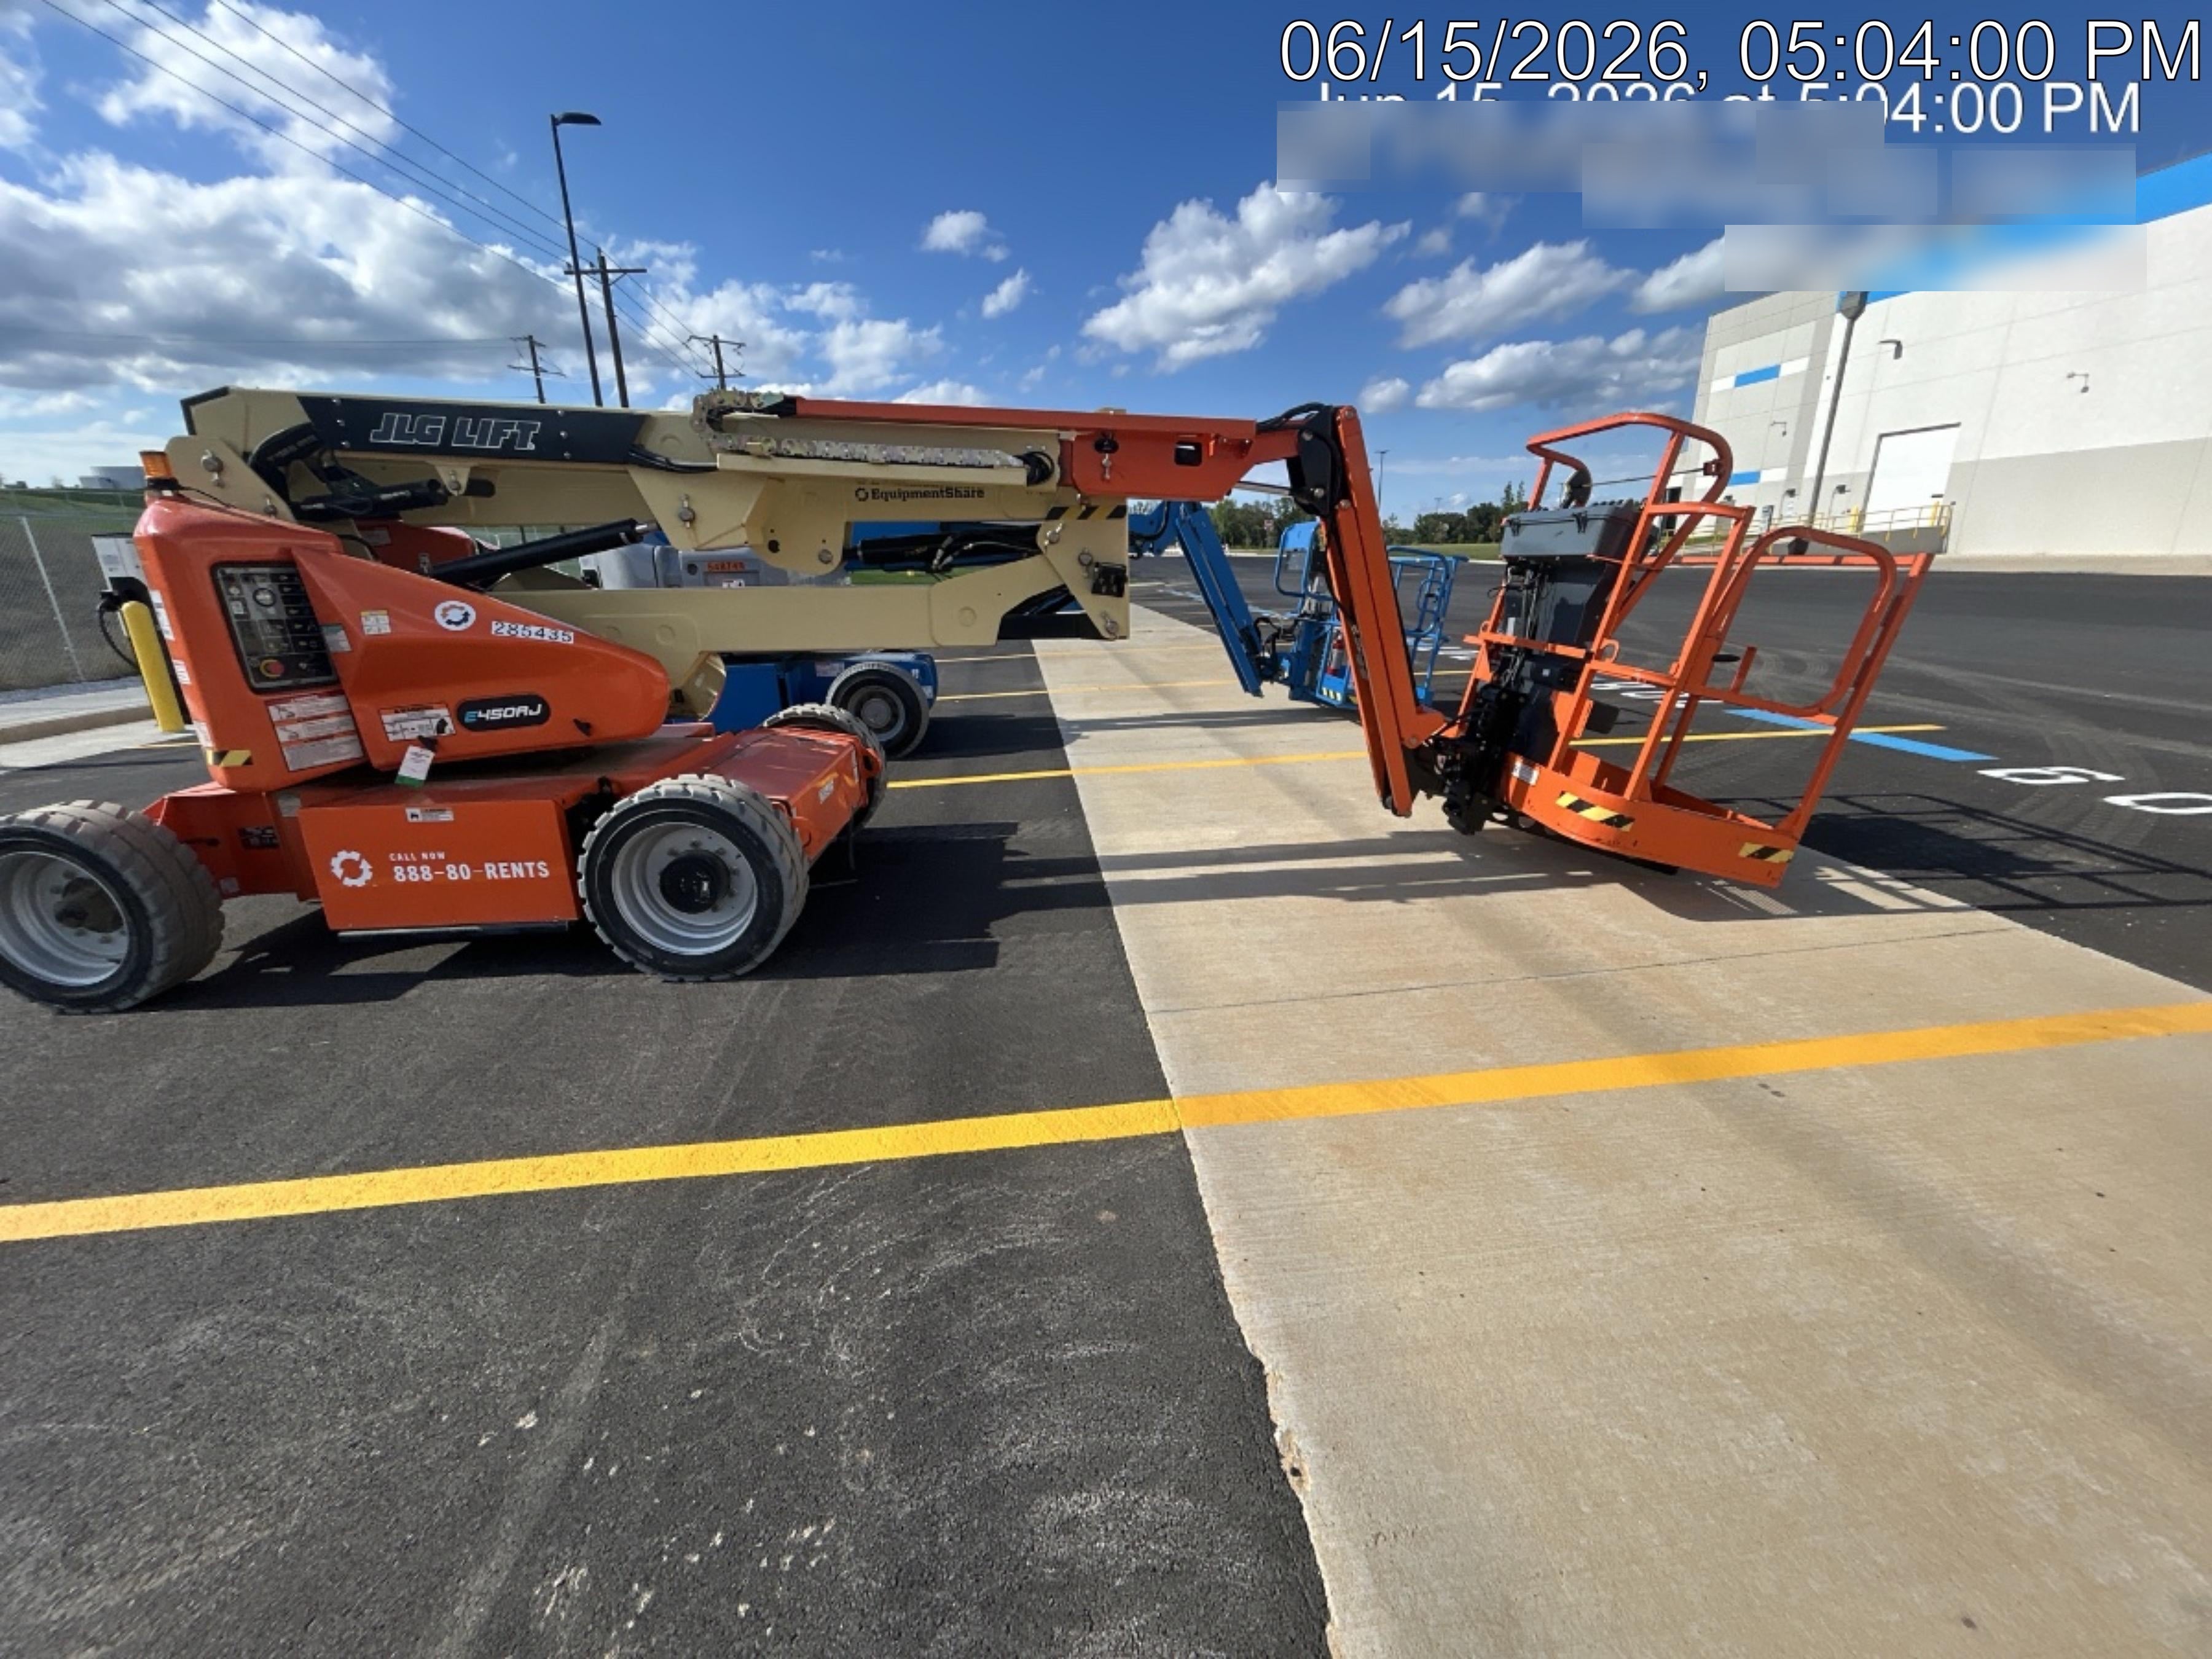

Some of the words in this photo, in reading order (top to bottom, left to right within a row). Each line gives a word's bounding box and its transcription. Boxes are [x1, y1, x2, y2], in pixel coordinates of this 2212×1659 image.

[370, 412, 447, 446] JLG
[451, 417, 541, 450] LIFT
[871, 487, 986, 502] EquipmentShare
[495, 622, 572, 642] 285435
[464, 704, 542, 723] E450AJ
[388, 852, 418, 861] CALL
[421, 852, 445, 860] NOW
[393, 861, 550, 882] 888-80-RENTS
